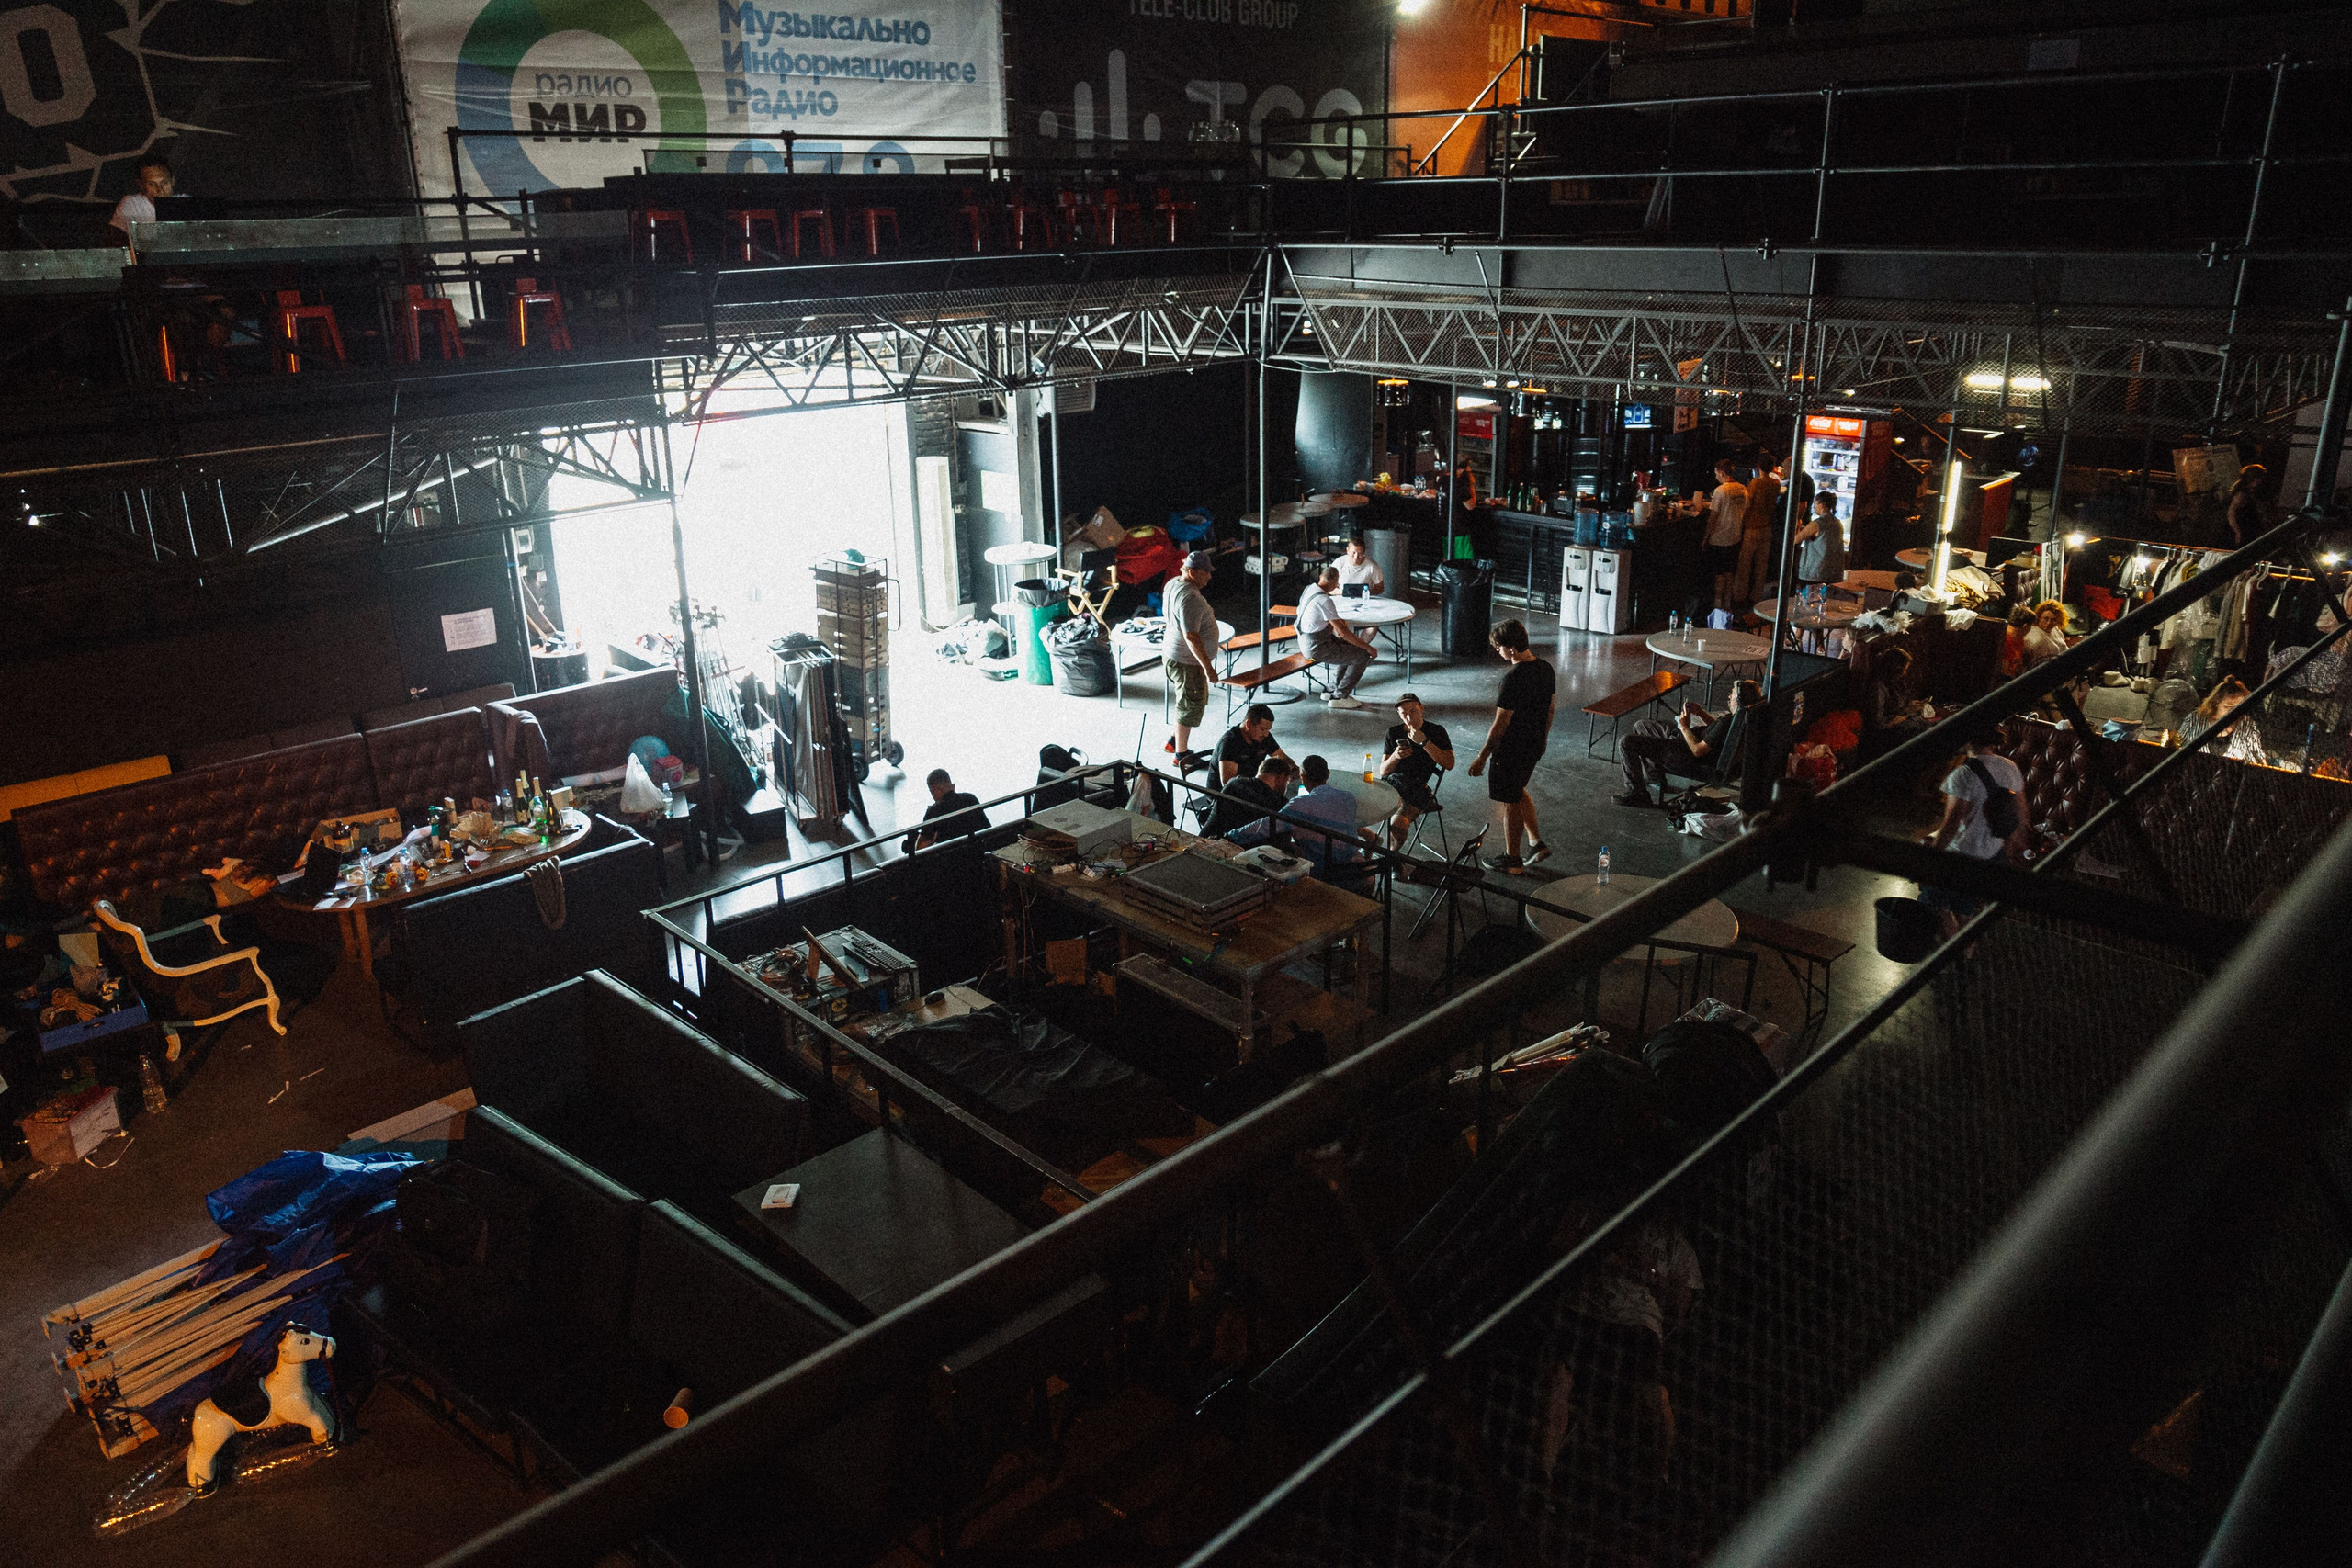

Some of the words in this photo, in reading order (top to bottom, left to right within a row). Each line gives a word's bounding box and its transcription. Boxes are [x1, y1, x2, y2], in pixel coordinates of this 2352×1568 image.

[718, 0, 931, 46] Музыкально
[1239, 0, 1299, 28] GROUP
[721, 40, 977, 85] Информационное
[535, 73, 632, 99] радио
[725, 78, 839, 120] Радио
[528, 102, 647, 142] МИР
